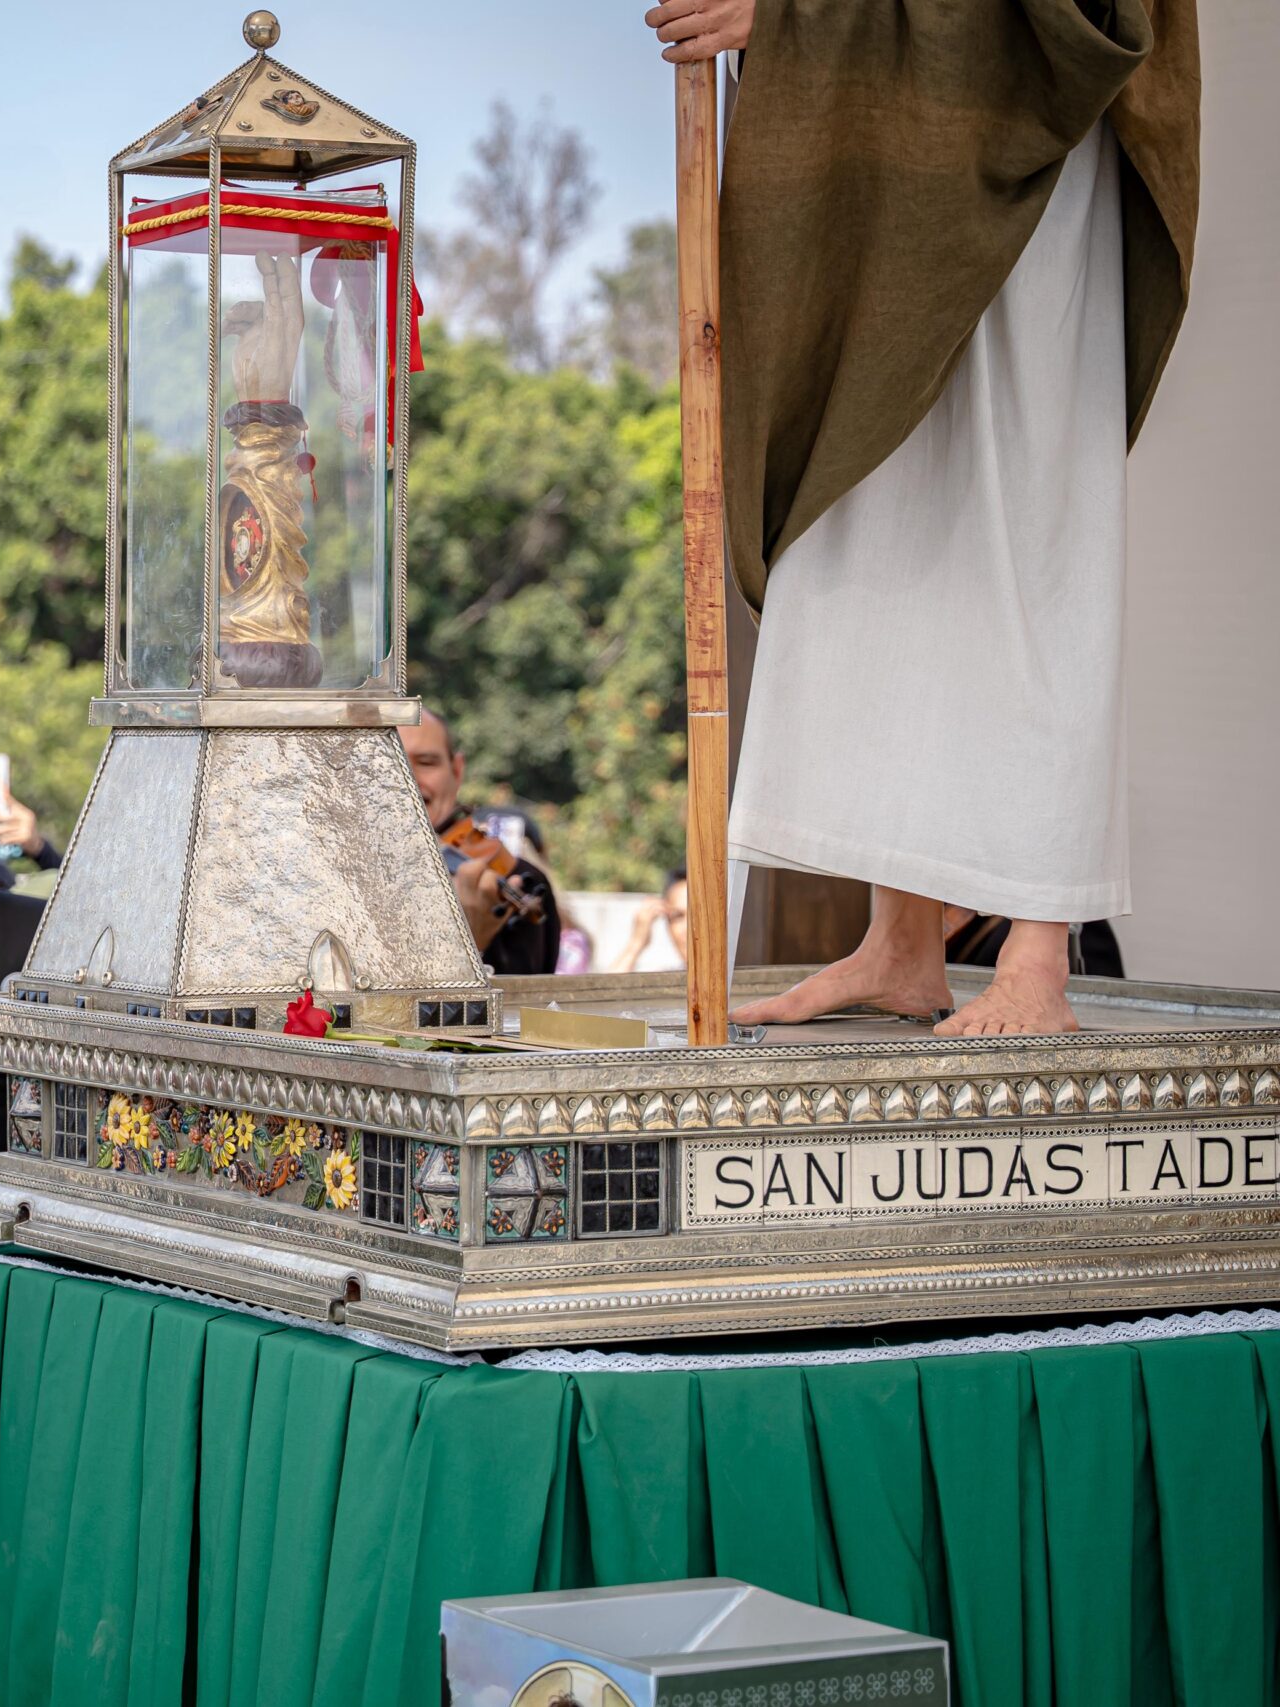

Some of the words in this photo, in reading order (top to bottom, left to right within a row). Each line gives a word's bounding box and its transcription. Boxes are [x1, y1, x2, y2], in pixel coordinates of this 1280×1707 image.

[715, 1151, 847, 1210] SAN
[871, 1144, 1084, 1202] JUDAS
[1106, 1133, 1280, 1192] TADE
